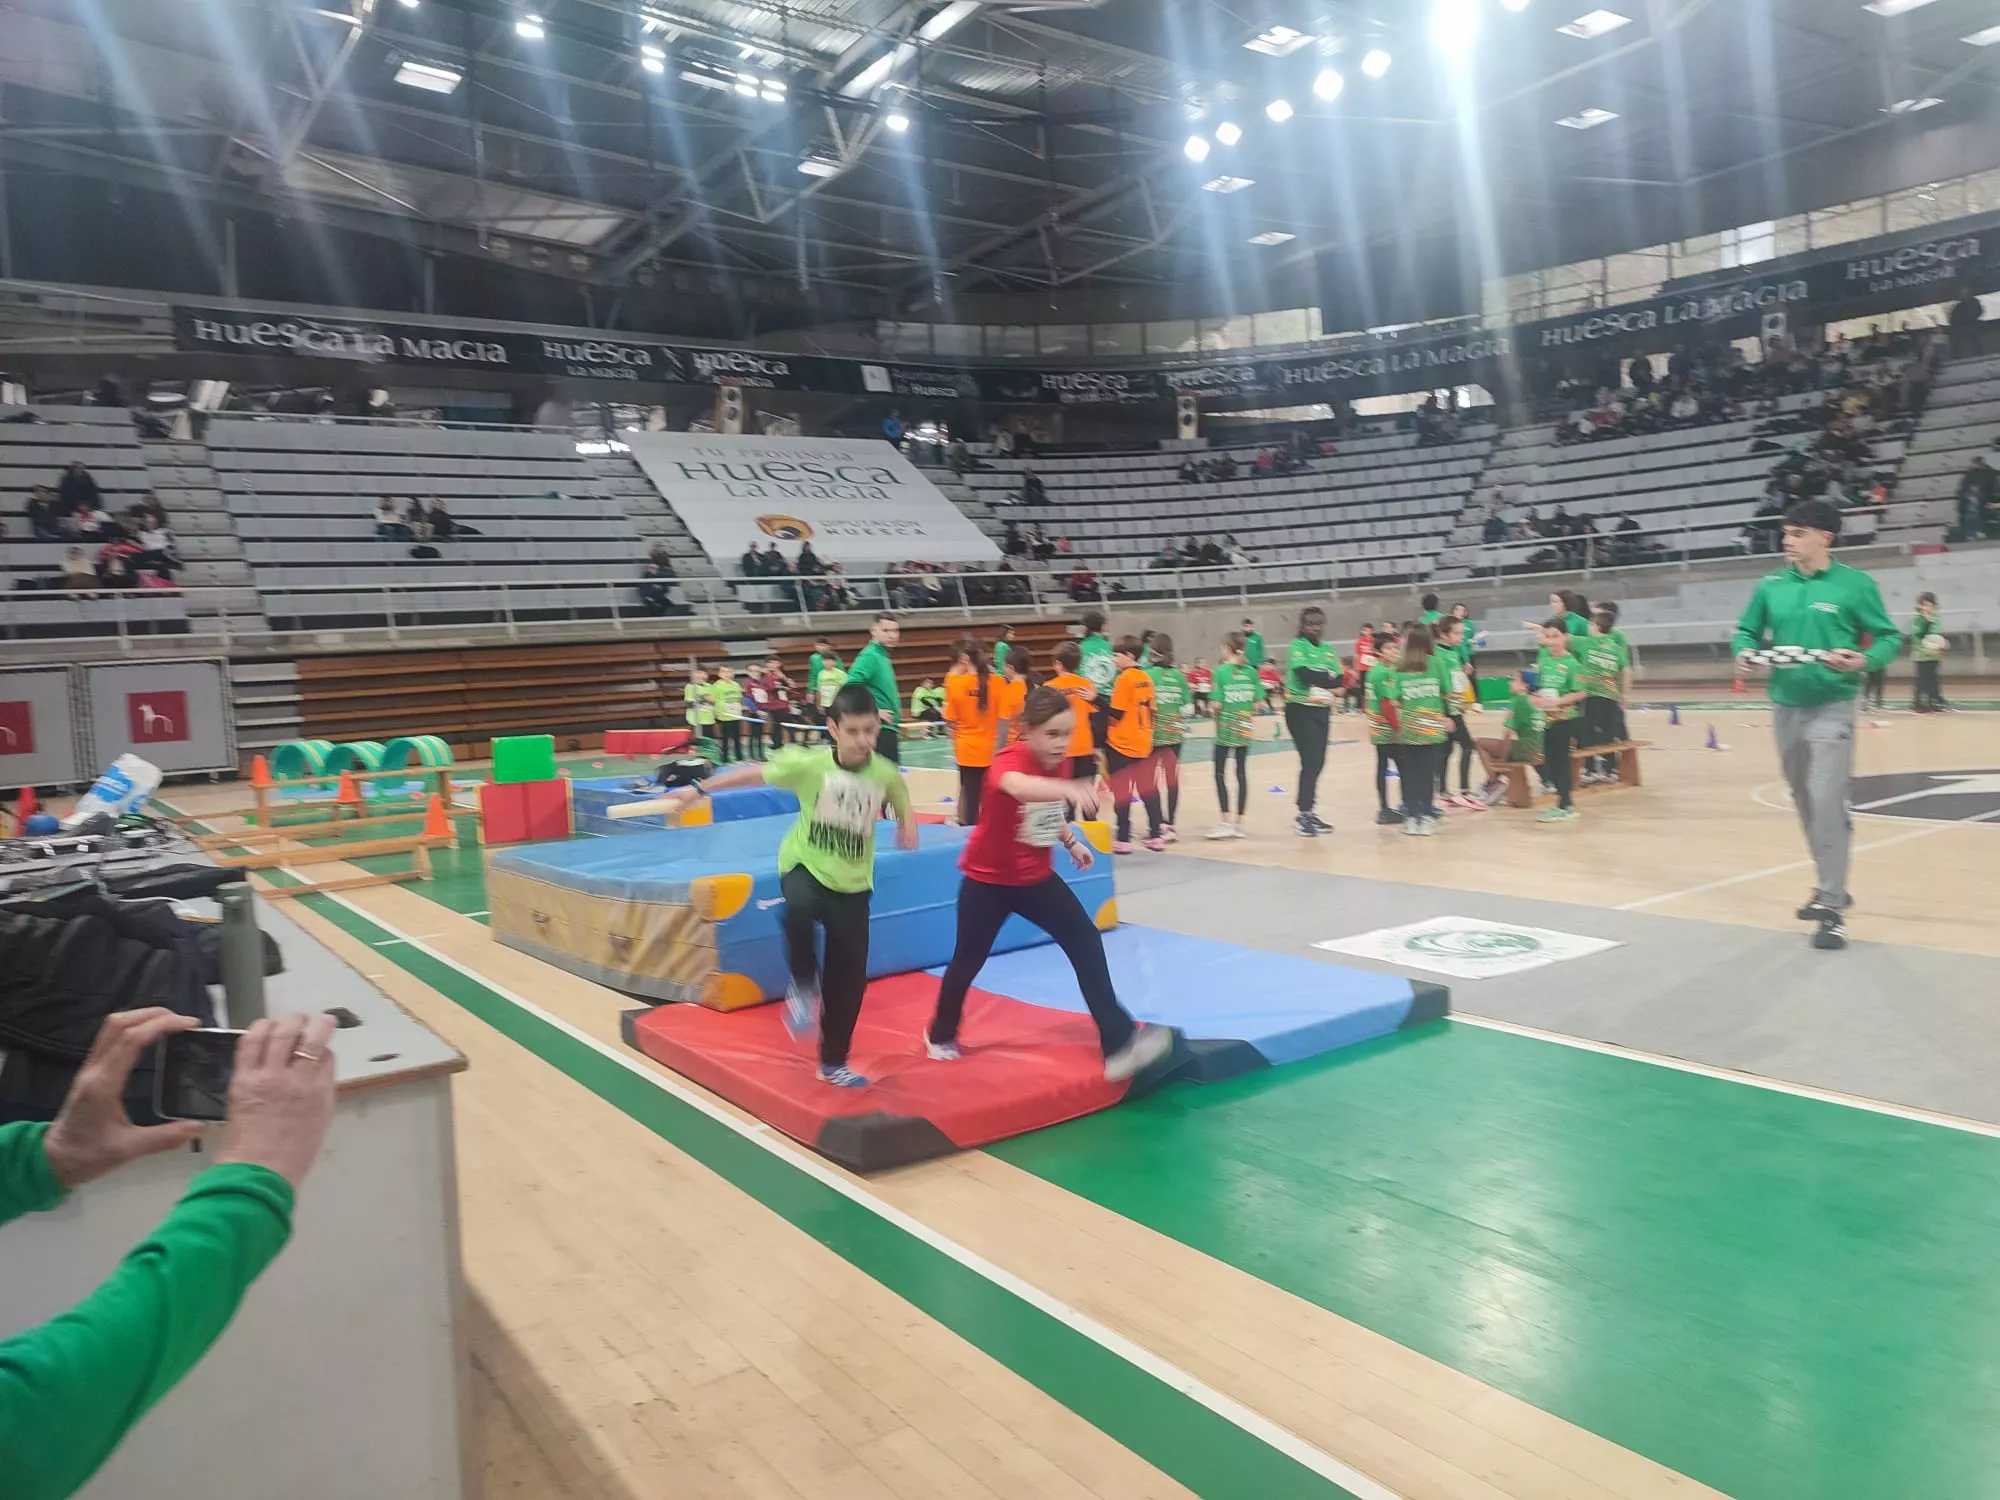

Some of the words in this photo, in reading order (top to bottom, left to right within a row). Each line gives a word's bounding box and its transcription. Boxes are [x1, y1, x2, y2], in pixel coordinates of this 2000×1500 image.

[1845, 238, 1982, 280] Huesca
[191, 318, 348, 352] Huesca
[1540, 309, 1658, 347] Huesca
[542, 340, 654, 366] Huesca
[1284, 357, 1387, 384] Huesca
[671, 460, 904, 486] Huesca
